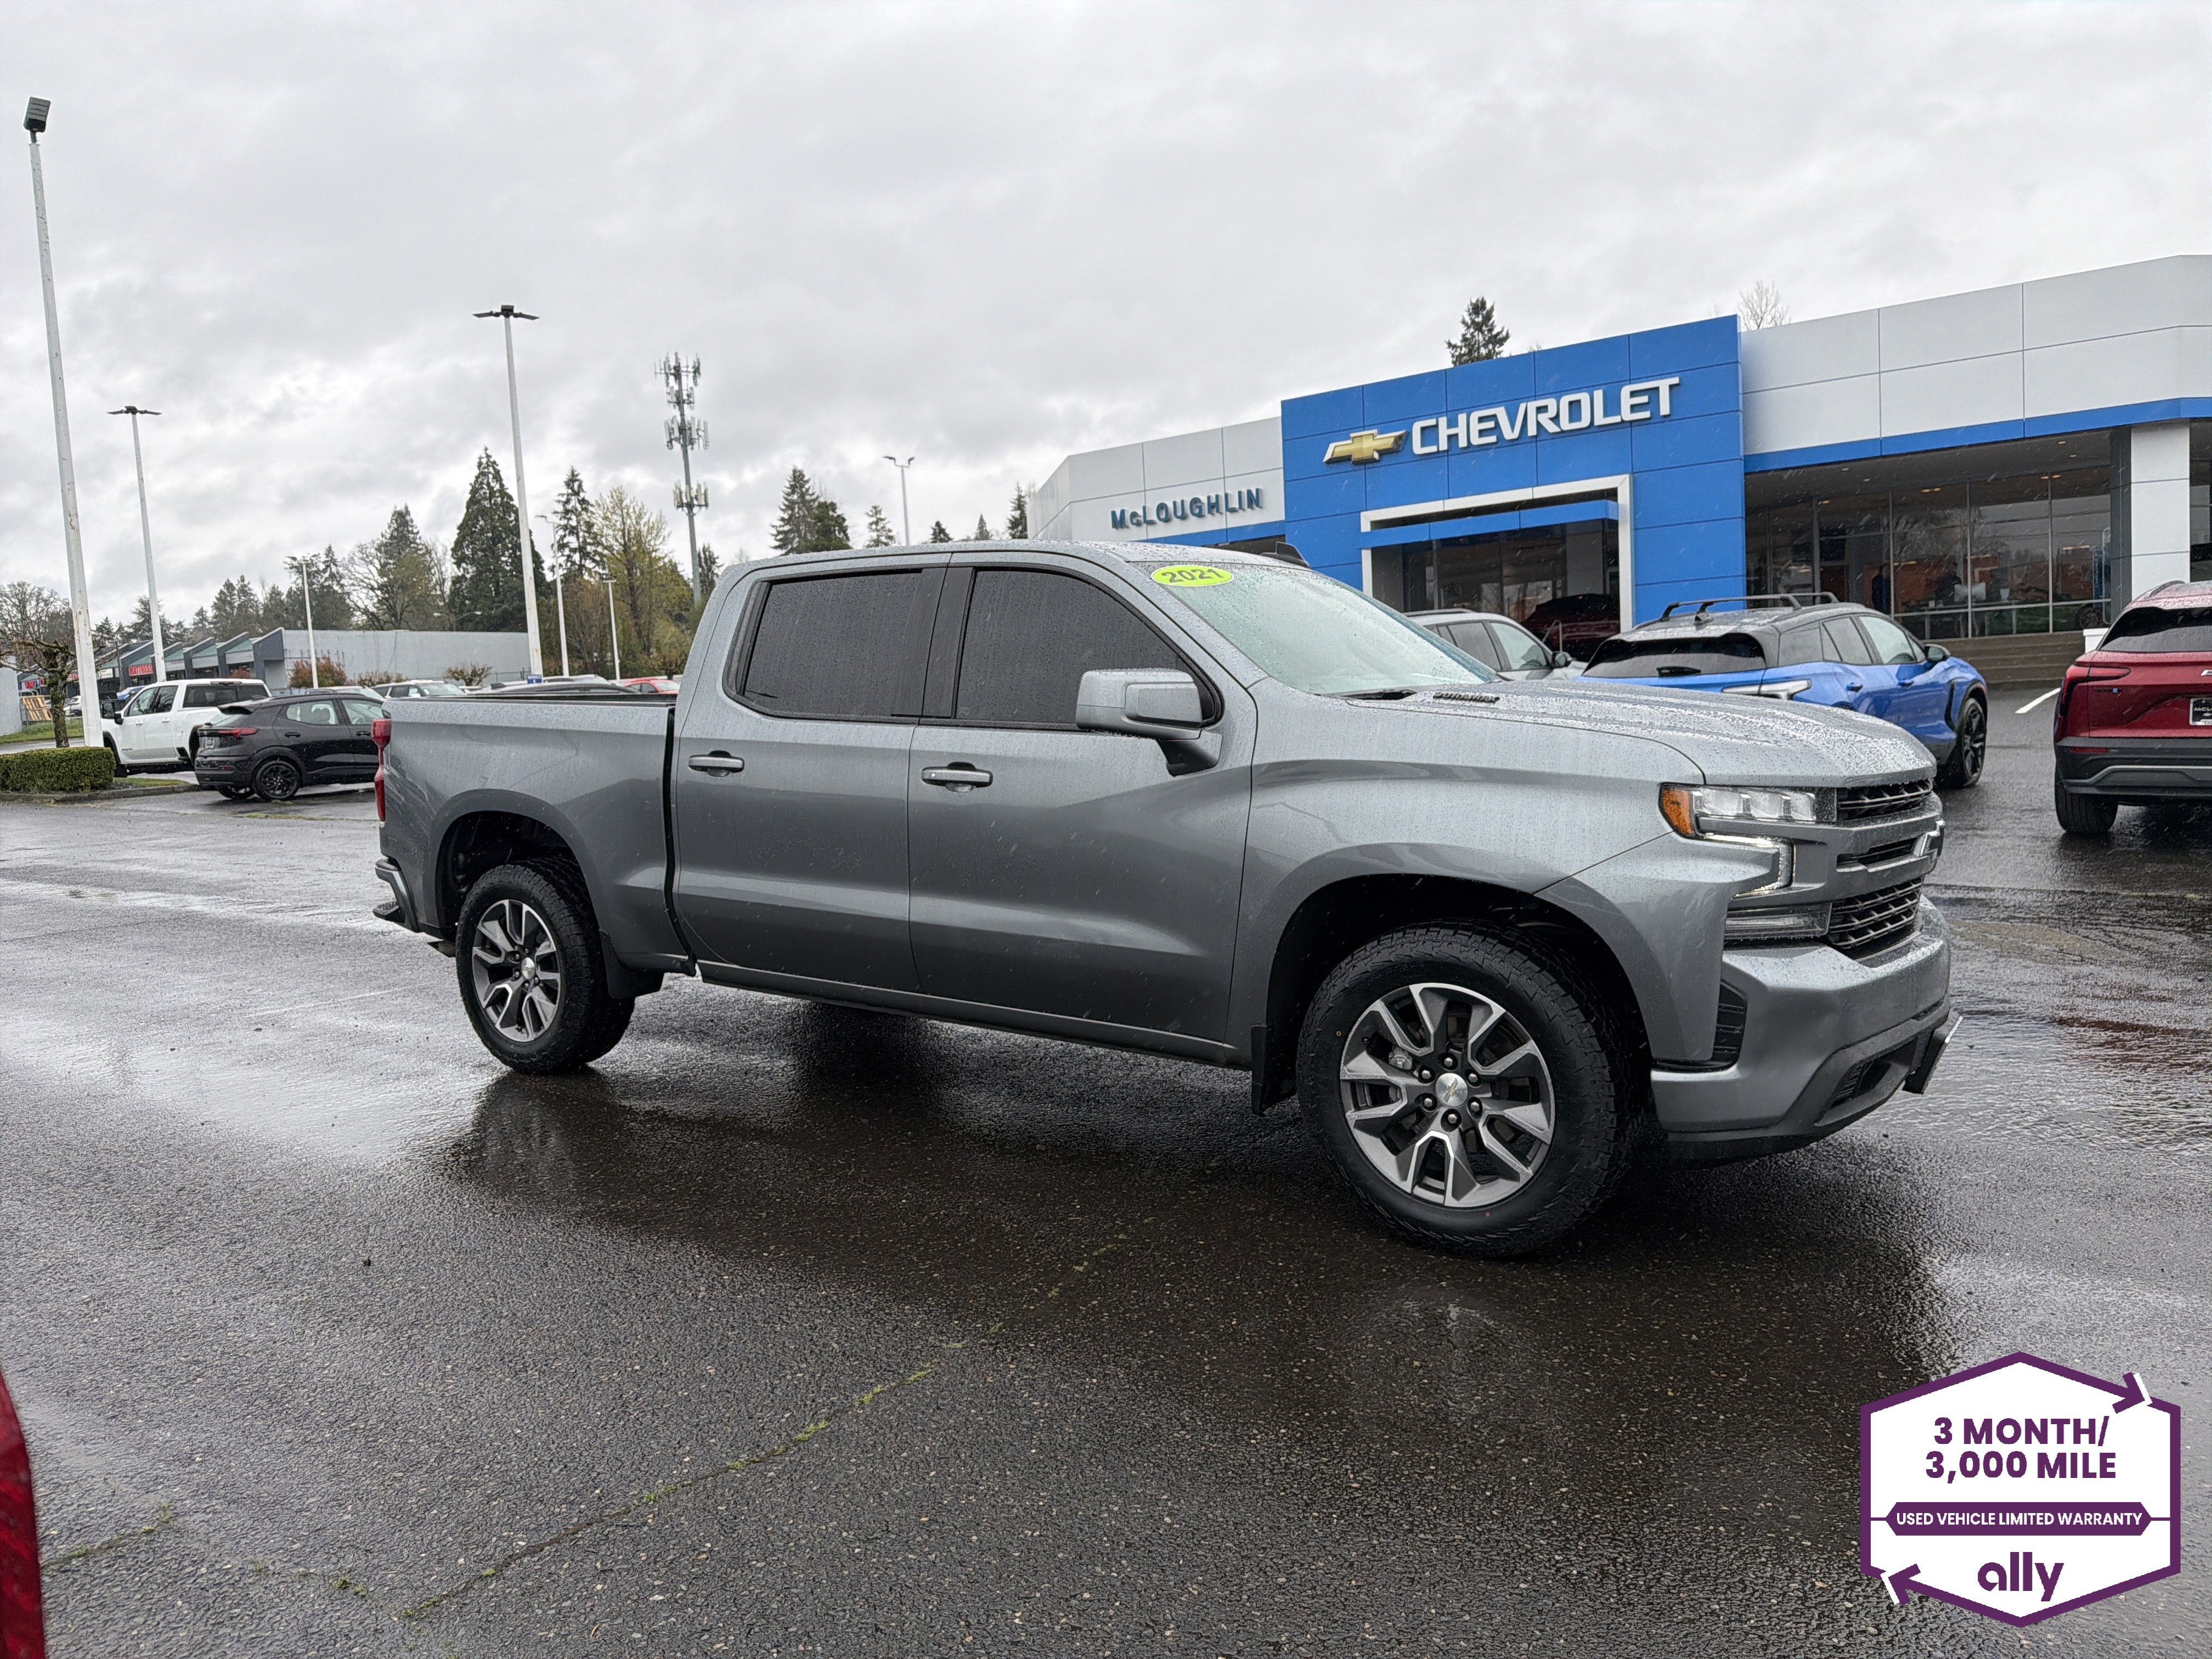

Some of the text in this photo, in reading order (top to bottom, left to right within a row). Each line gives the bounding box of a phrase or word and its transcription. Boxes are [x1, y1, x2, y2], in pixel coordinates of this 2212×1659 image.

[1412, 377, 1679, 455] CHEVROLET
[1111, 487, 1261, 529] McLOUGHLIN
[1161, 568, 1225, 583] 2021
[130, 665, 153, 674] MATTRESS
